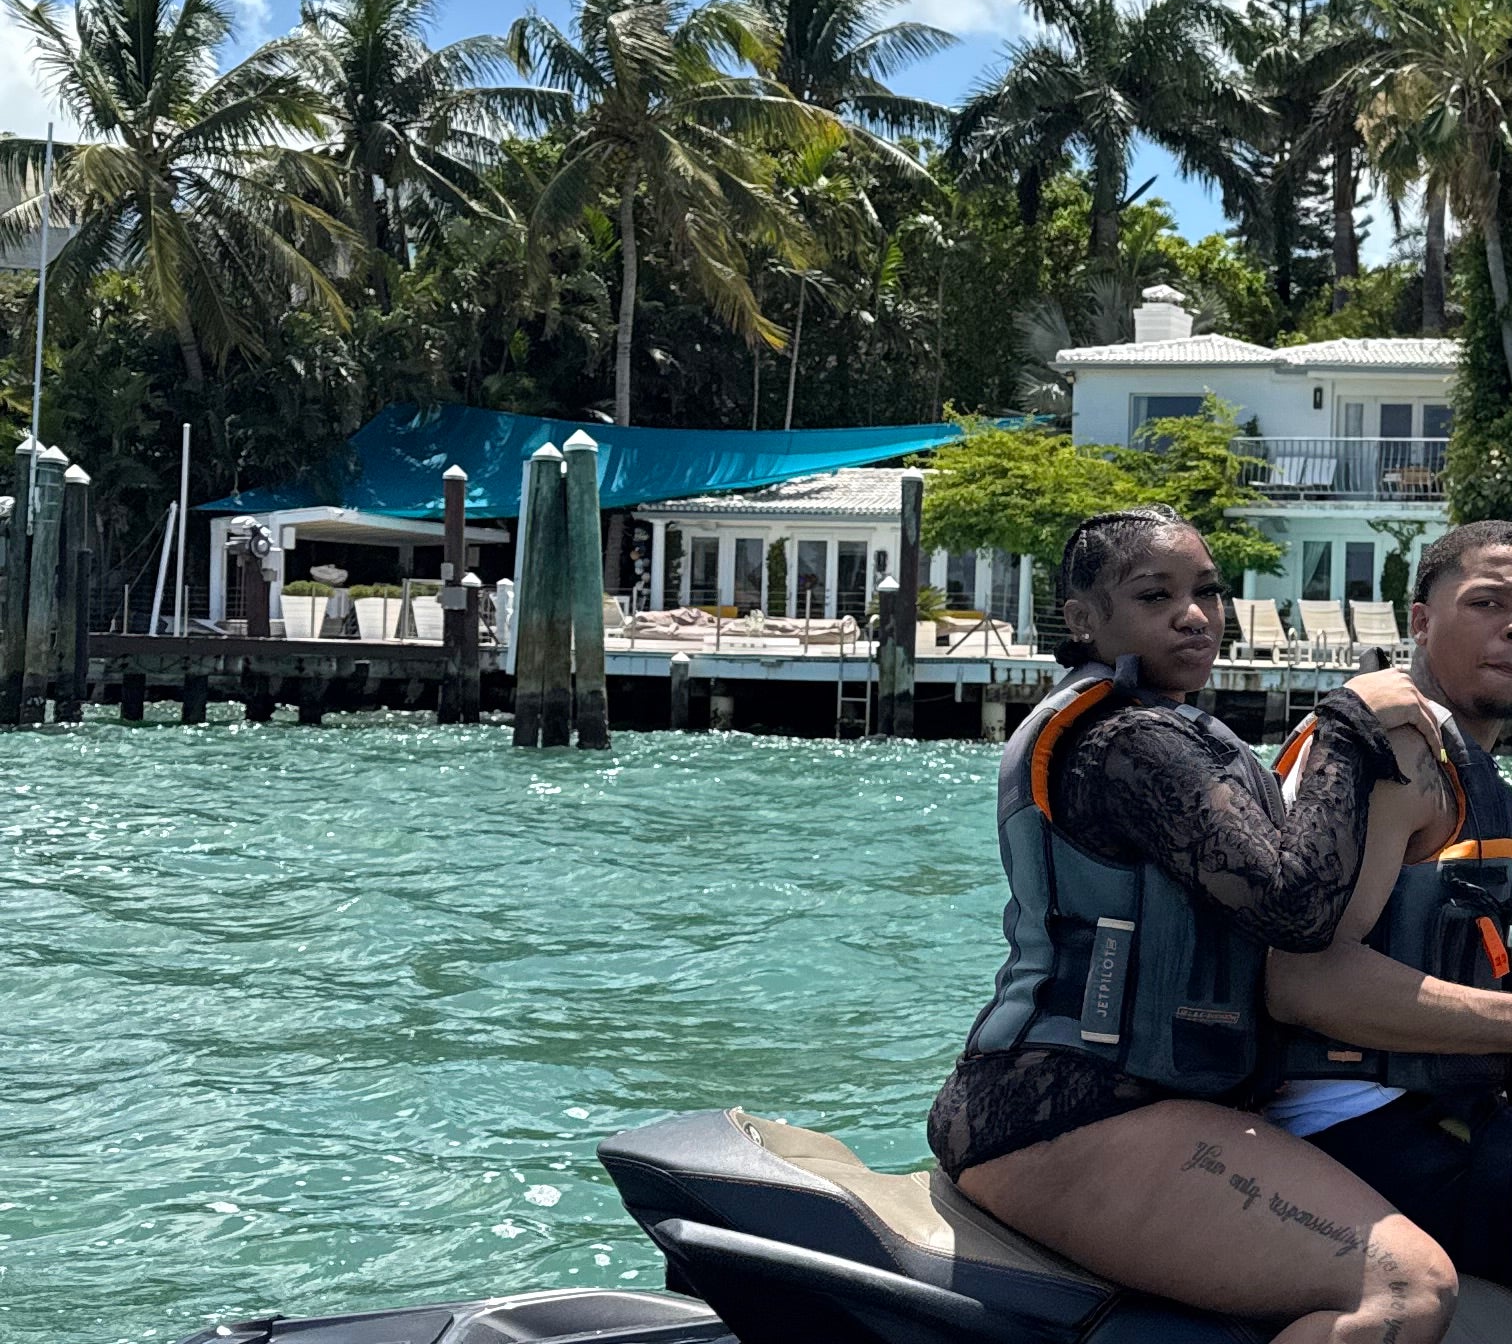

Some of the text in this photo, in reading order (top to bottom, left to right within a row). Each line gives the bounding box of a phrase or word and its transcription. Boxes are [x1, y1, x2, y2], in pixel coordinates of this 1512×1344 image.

[1096, 949, 1117, 1017] JETPILOT
[1229, 1173, 1261, 1210] only
[1269, 1192, 1363, 1256] responsibility
